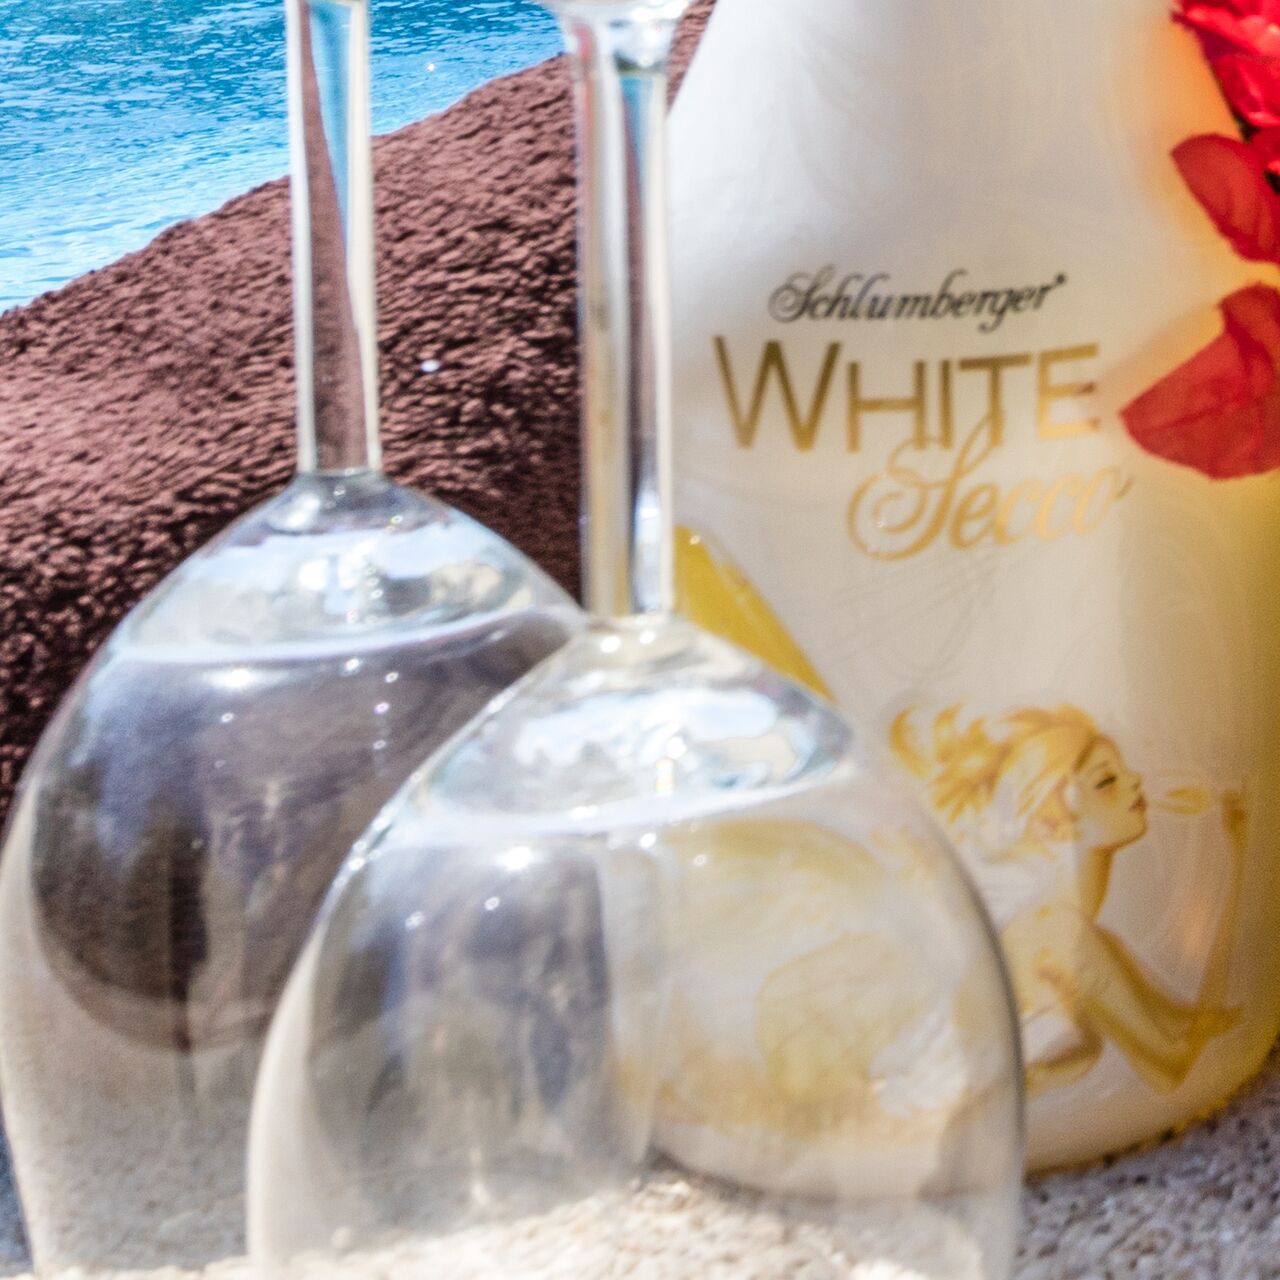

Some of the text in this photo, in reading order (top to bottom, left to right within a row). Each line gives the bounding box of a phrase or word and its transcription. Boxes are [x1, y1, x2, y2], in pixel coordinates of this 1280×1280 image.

[769, 263, 1067, 332] Schlumberger
[713, 334, 1099, 452] WHITE
[847, 412, 1132, 561] Secco
